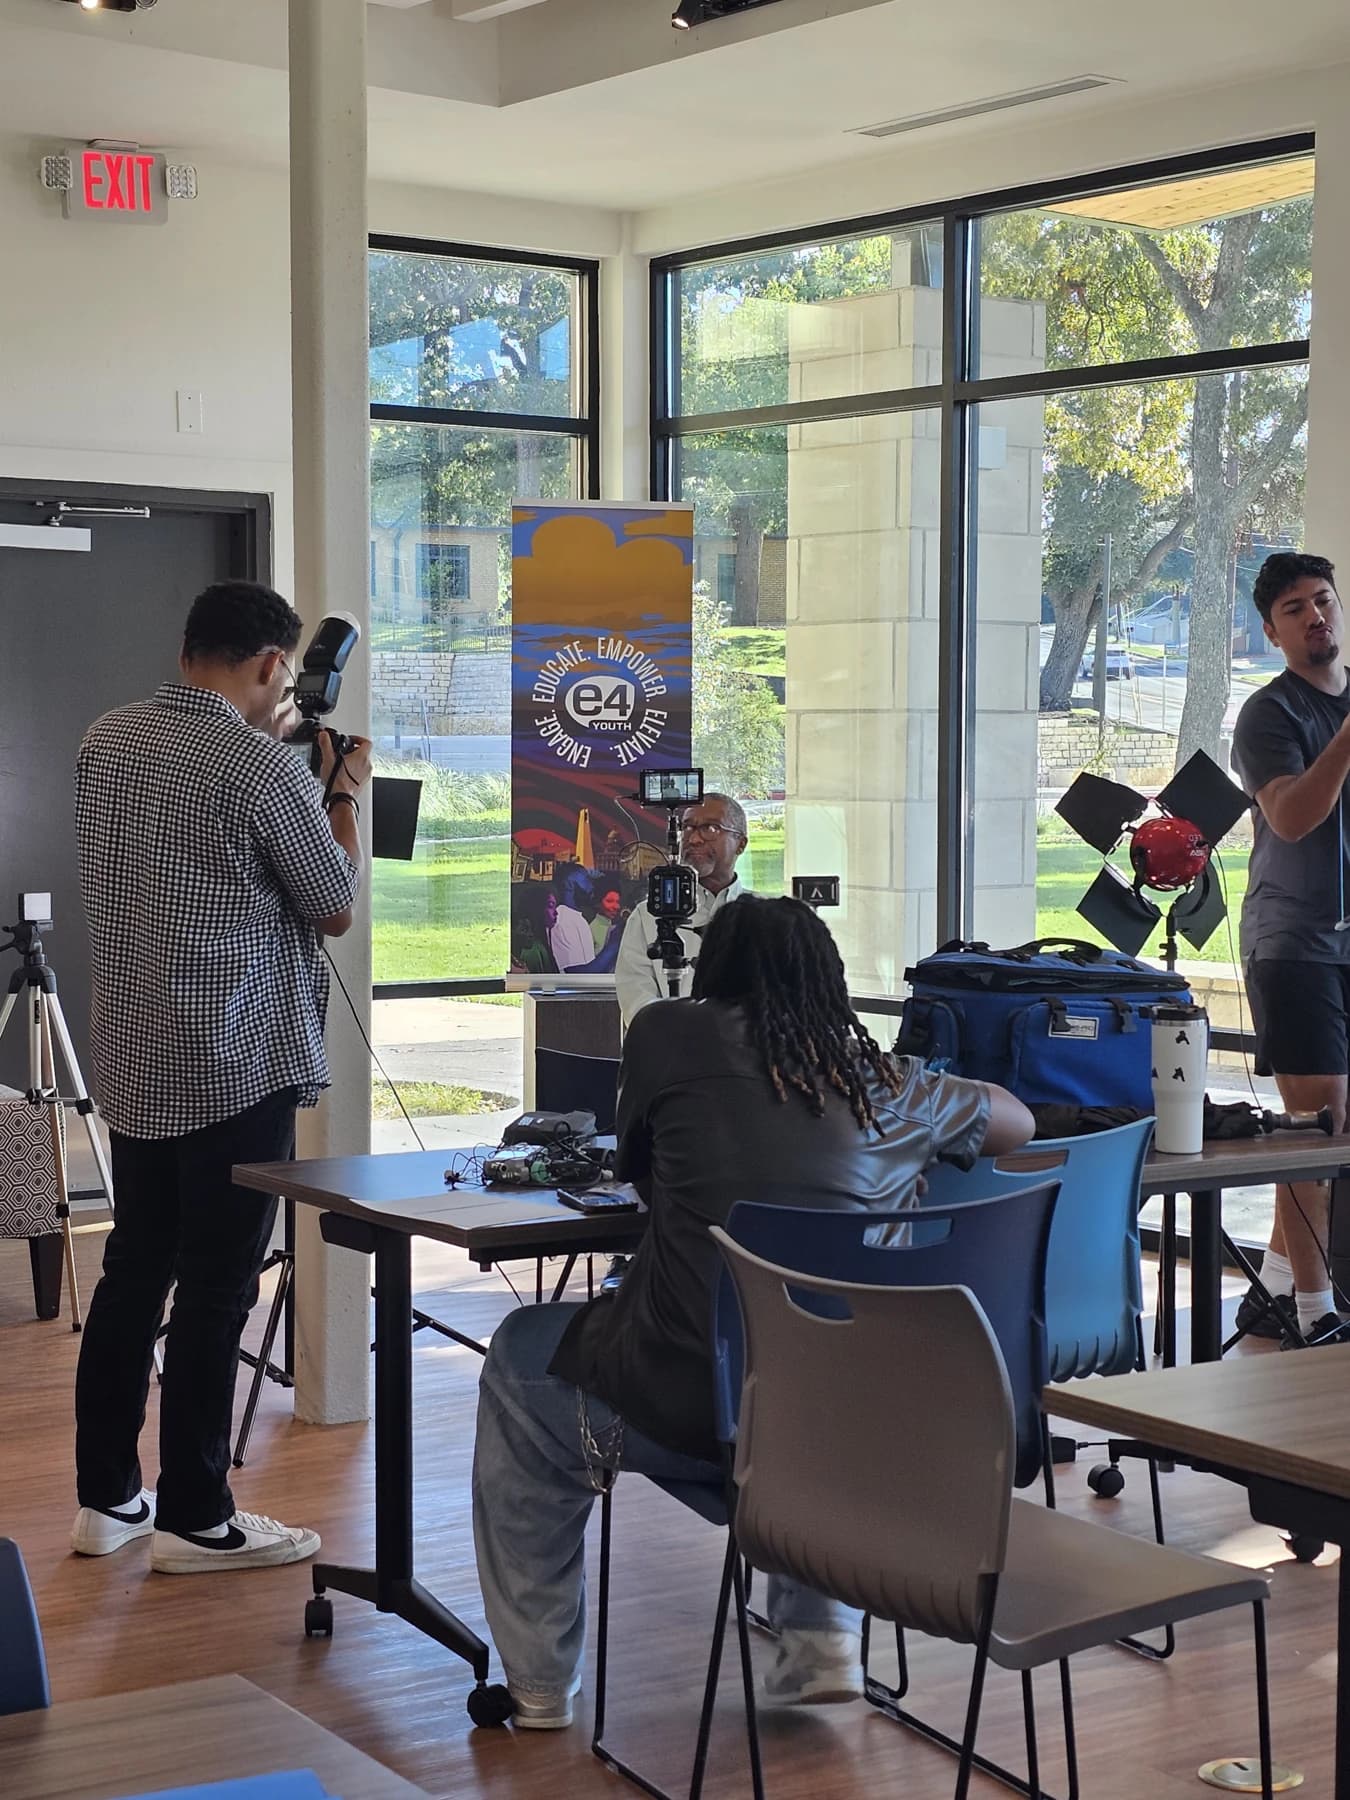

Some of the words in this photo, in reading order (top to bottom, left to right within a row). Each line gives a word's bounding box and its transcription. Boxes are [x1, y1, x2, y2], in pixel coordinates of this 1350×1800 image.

[82, 151, 155, 212] EXIT
[532, 640, 591, 703] EDUCATE.
[597, 636, 667, 702] EMPOWER.
[573, 684, 631, 717] e4
[592, 722, 632, 731] YOUTH
[535, 709, 591, 768] ENGAGE.
[609, 708, 667, 767] ELEVATE.
